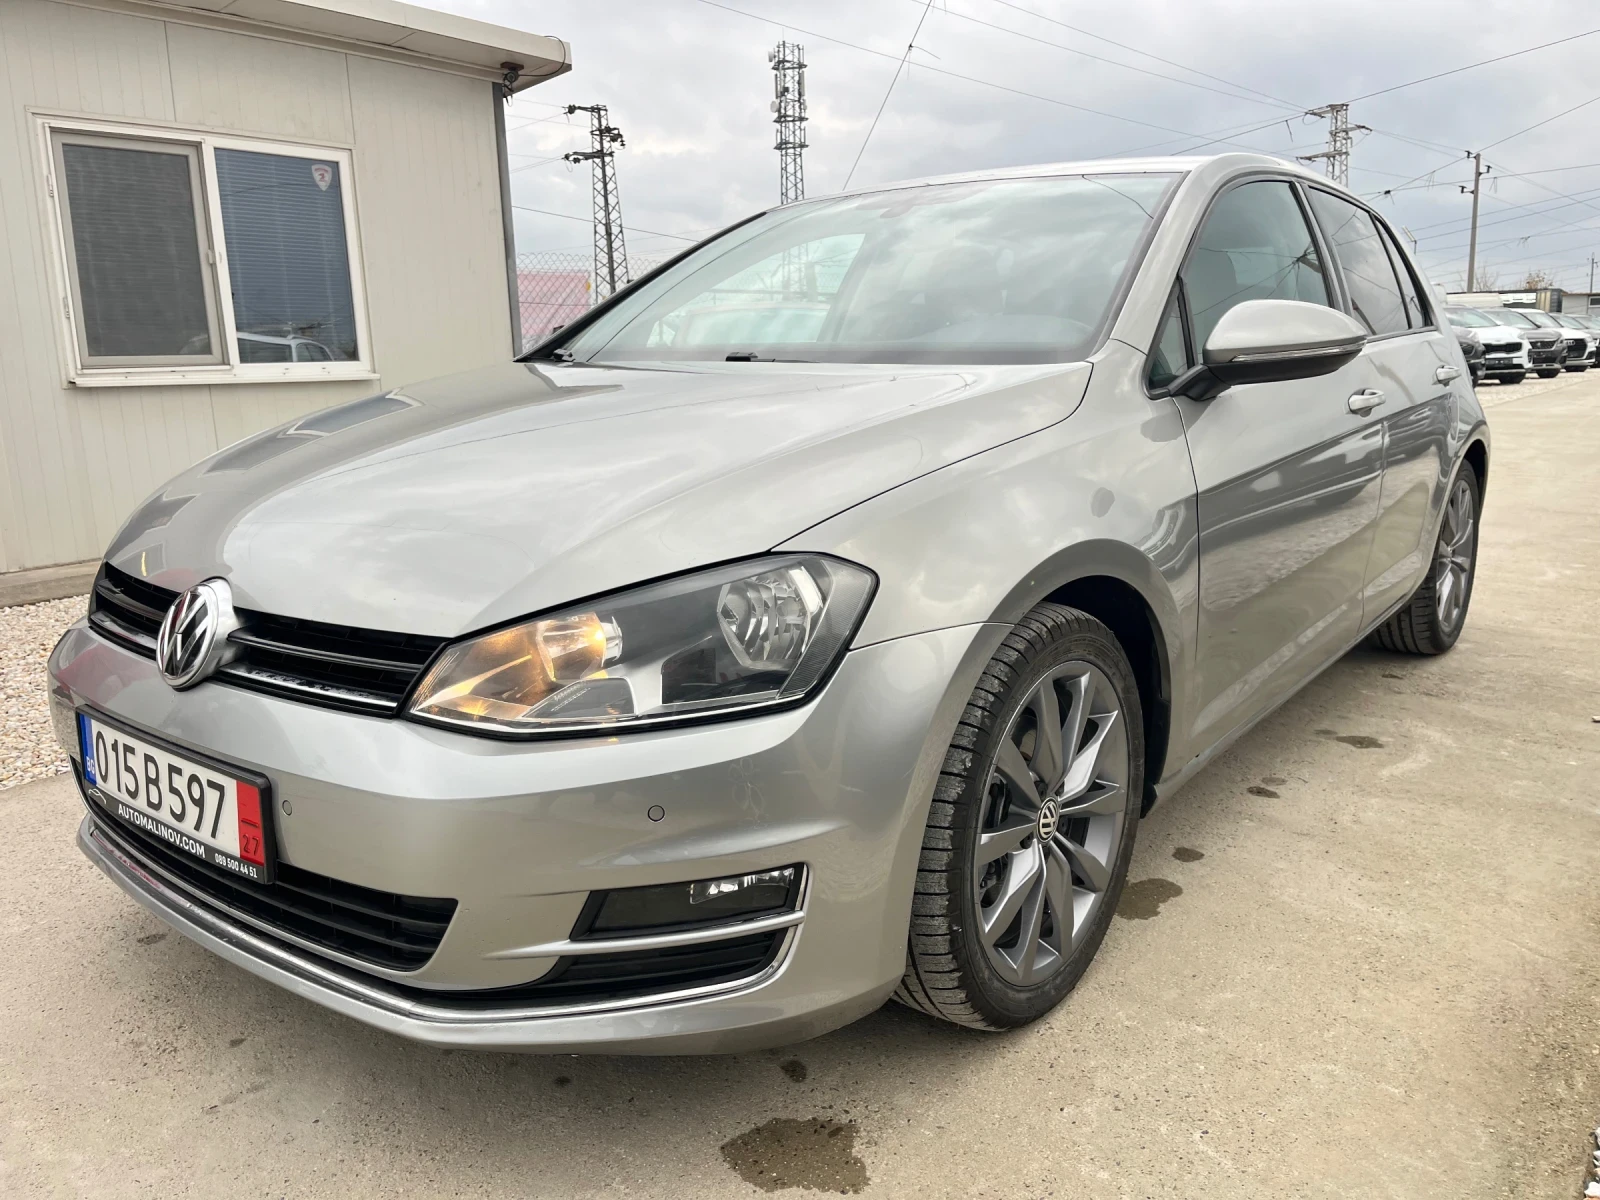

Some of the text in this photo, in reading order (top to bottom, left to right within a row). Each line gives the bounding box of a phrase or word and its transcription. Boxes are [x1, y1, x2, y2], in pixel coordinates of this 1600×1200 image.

[86, 756, 96, 774] BG
[118, 803, 206, 859] AUTOMALINOV.COM
[227, 858, 239, 872] 500
[240, 863, 249, 875] 44
[249, 866, 258, 878] 51
[242, 833, 259, 856] 27
